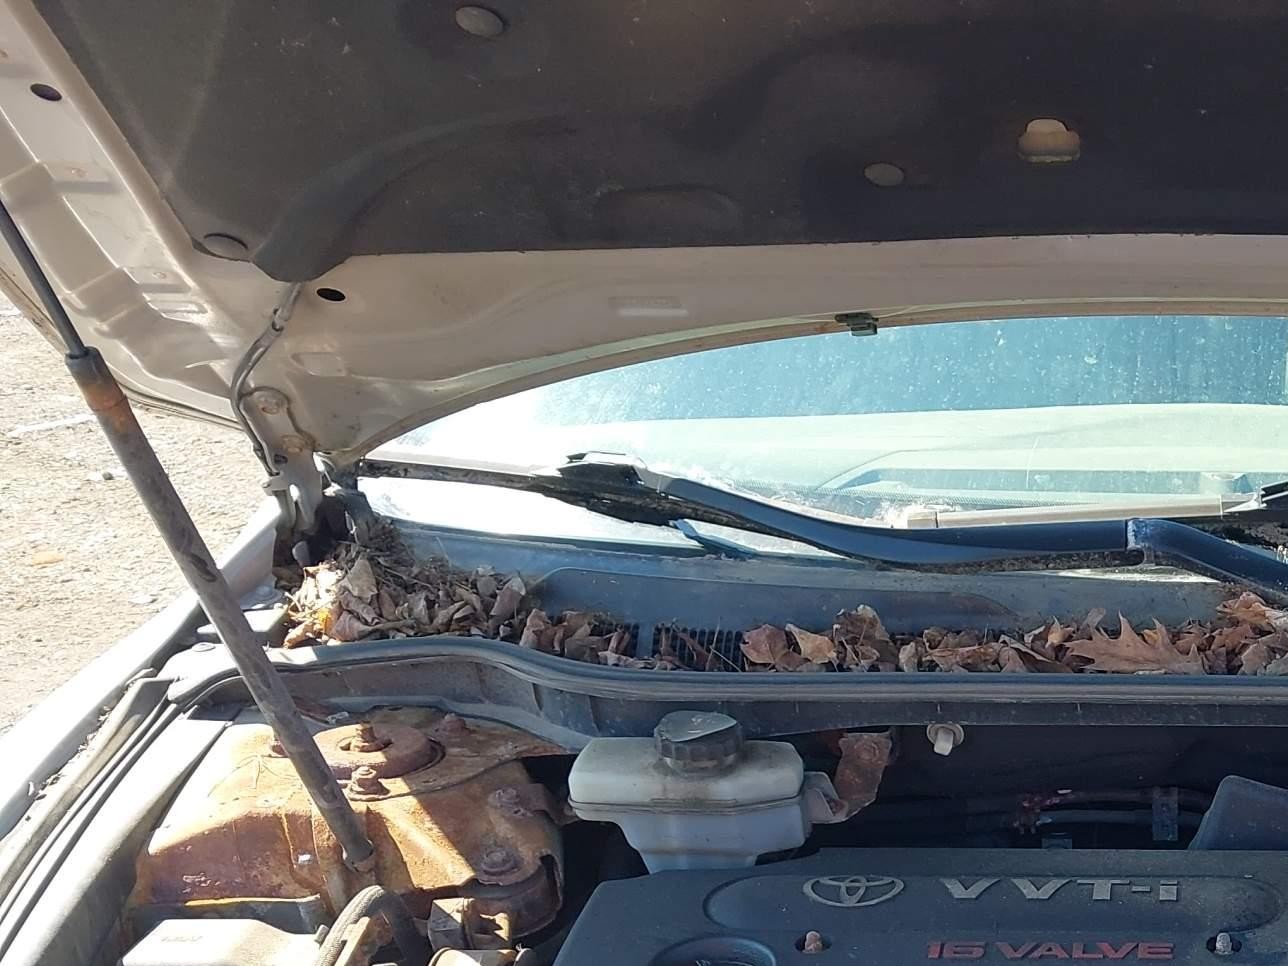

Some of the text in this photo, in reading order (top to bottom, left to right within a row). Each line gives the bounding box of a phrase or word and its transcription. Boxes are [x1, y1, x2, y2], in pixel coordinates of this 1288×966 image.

[940, 878, 1178, 901] VVT-i
[927, 941, 1174, 960] 16 VALVE
